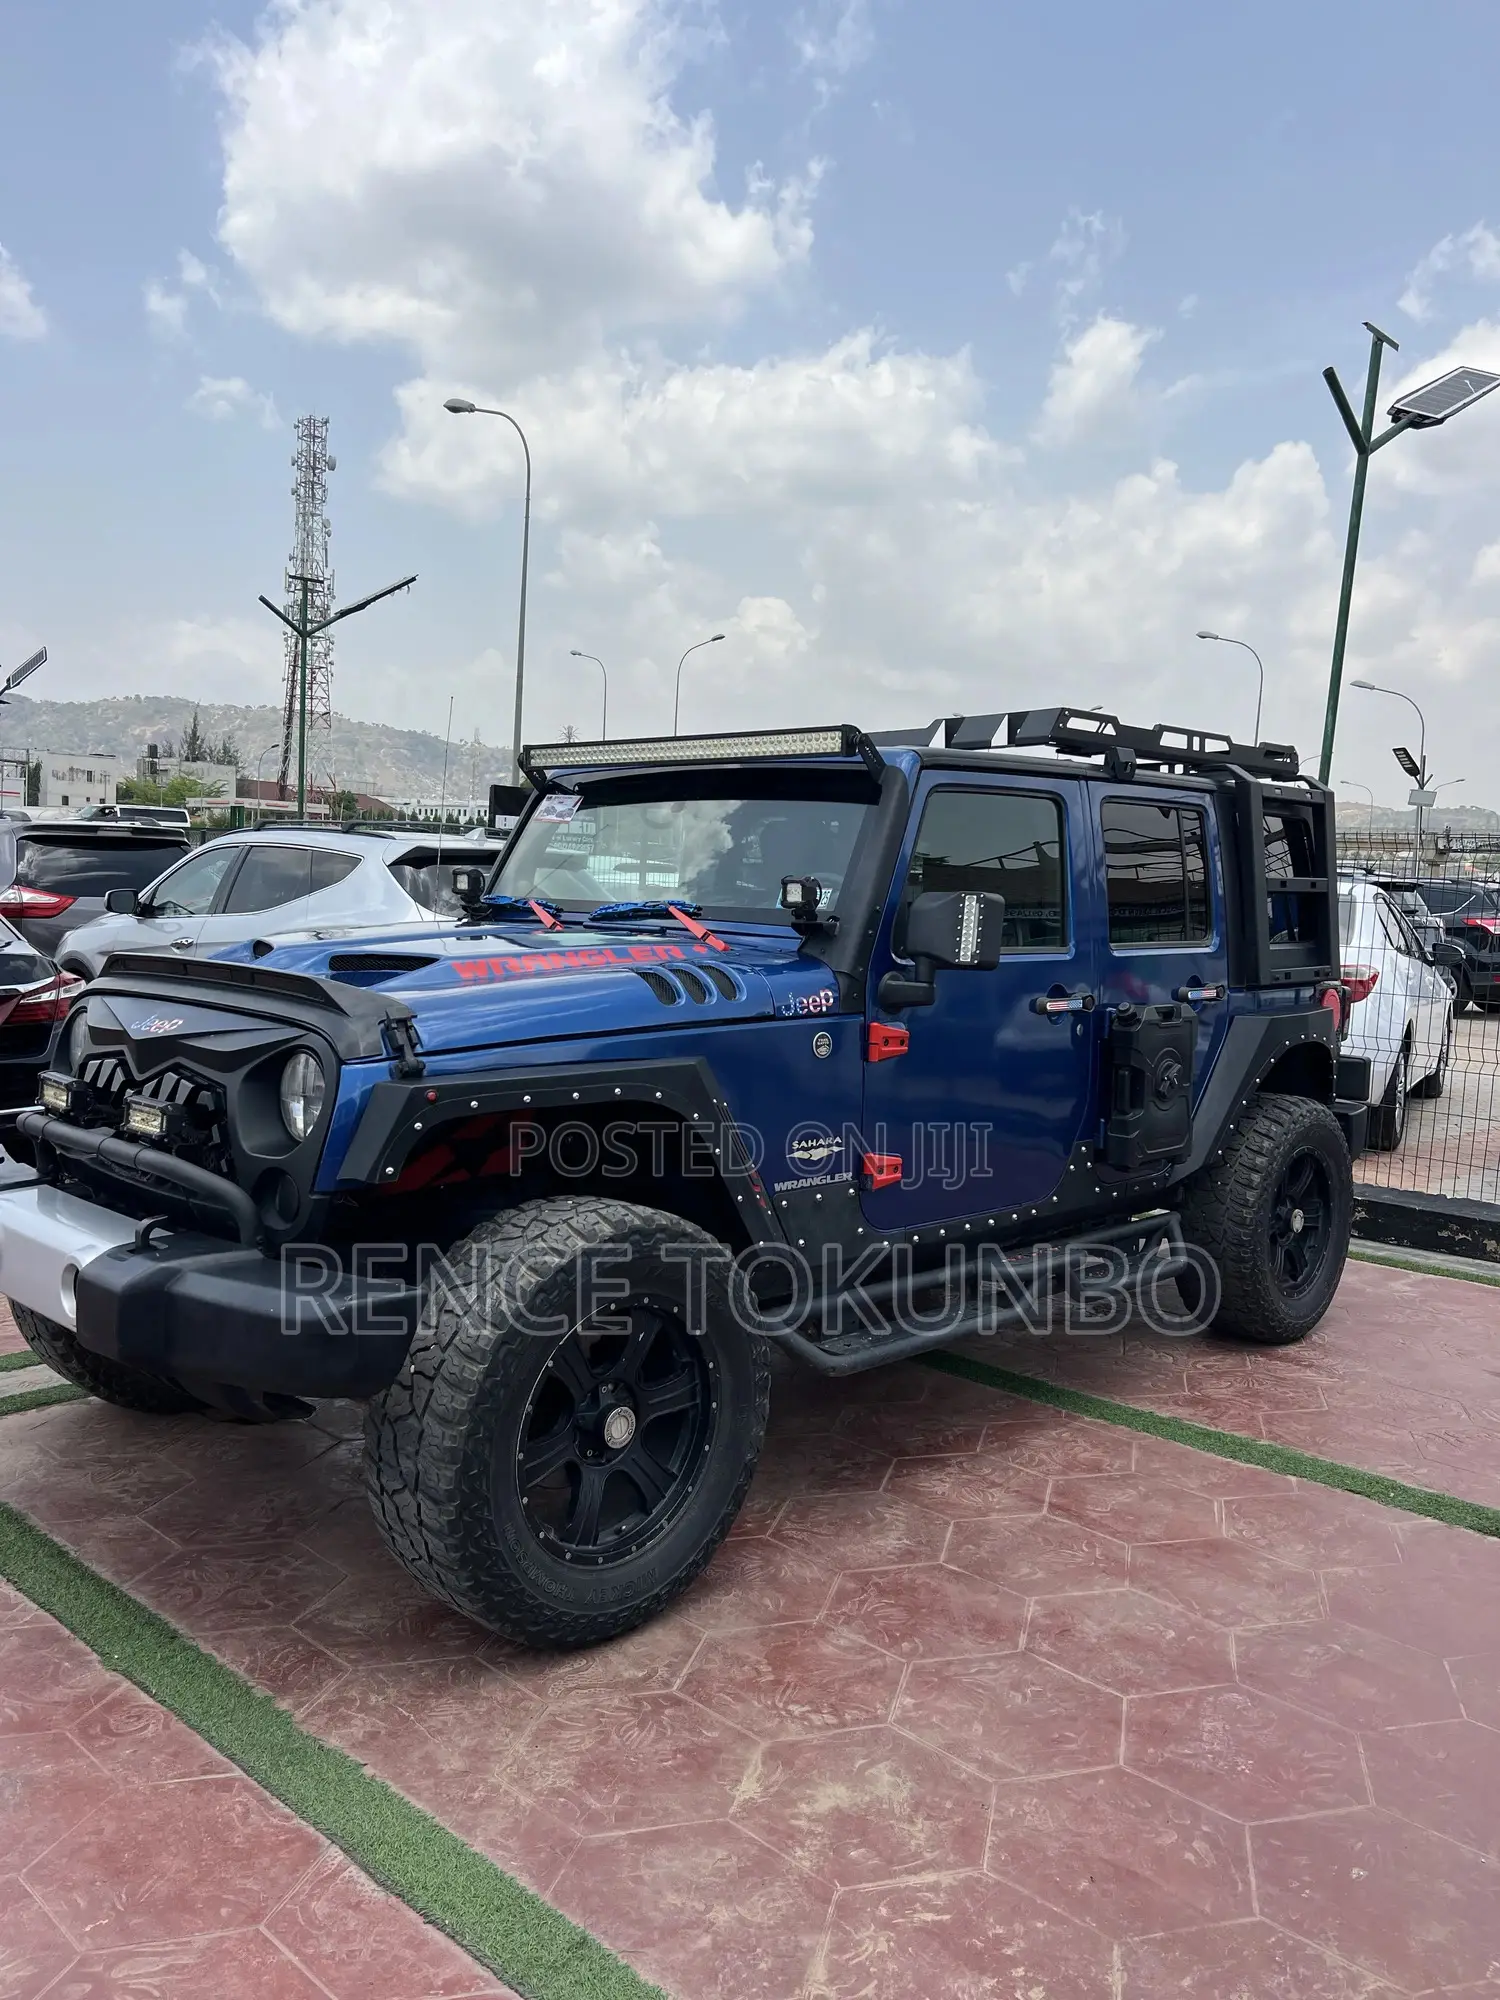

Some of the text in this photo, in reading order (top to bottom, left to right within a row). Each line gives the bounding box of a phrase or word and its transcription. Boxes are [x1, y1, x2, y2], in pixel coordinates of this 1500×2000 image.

[451, 944, 687, 979] WRANGLER
[781, 989, 834, 1017] Jeep
[130, 1014, 185, 1034] Jeep
[791, 1136, 843, 1150] SAHARA
[773, 1171, 853, 1192] WRANGLER
[502, 1521, 660, 1605] MICKEY THOMPSON
